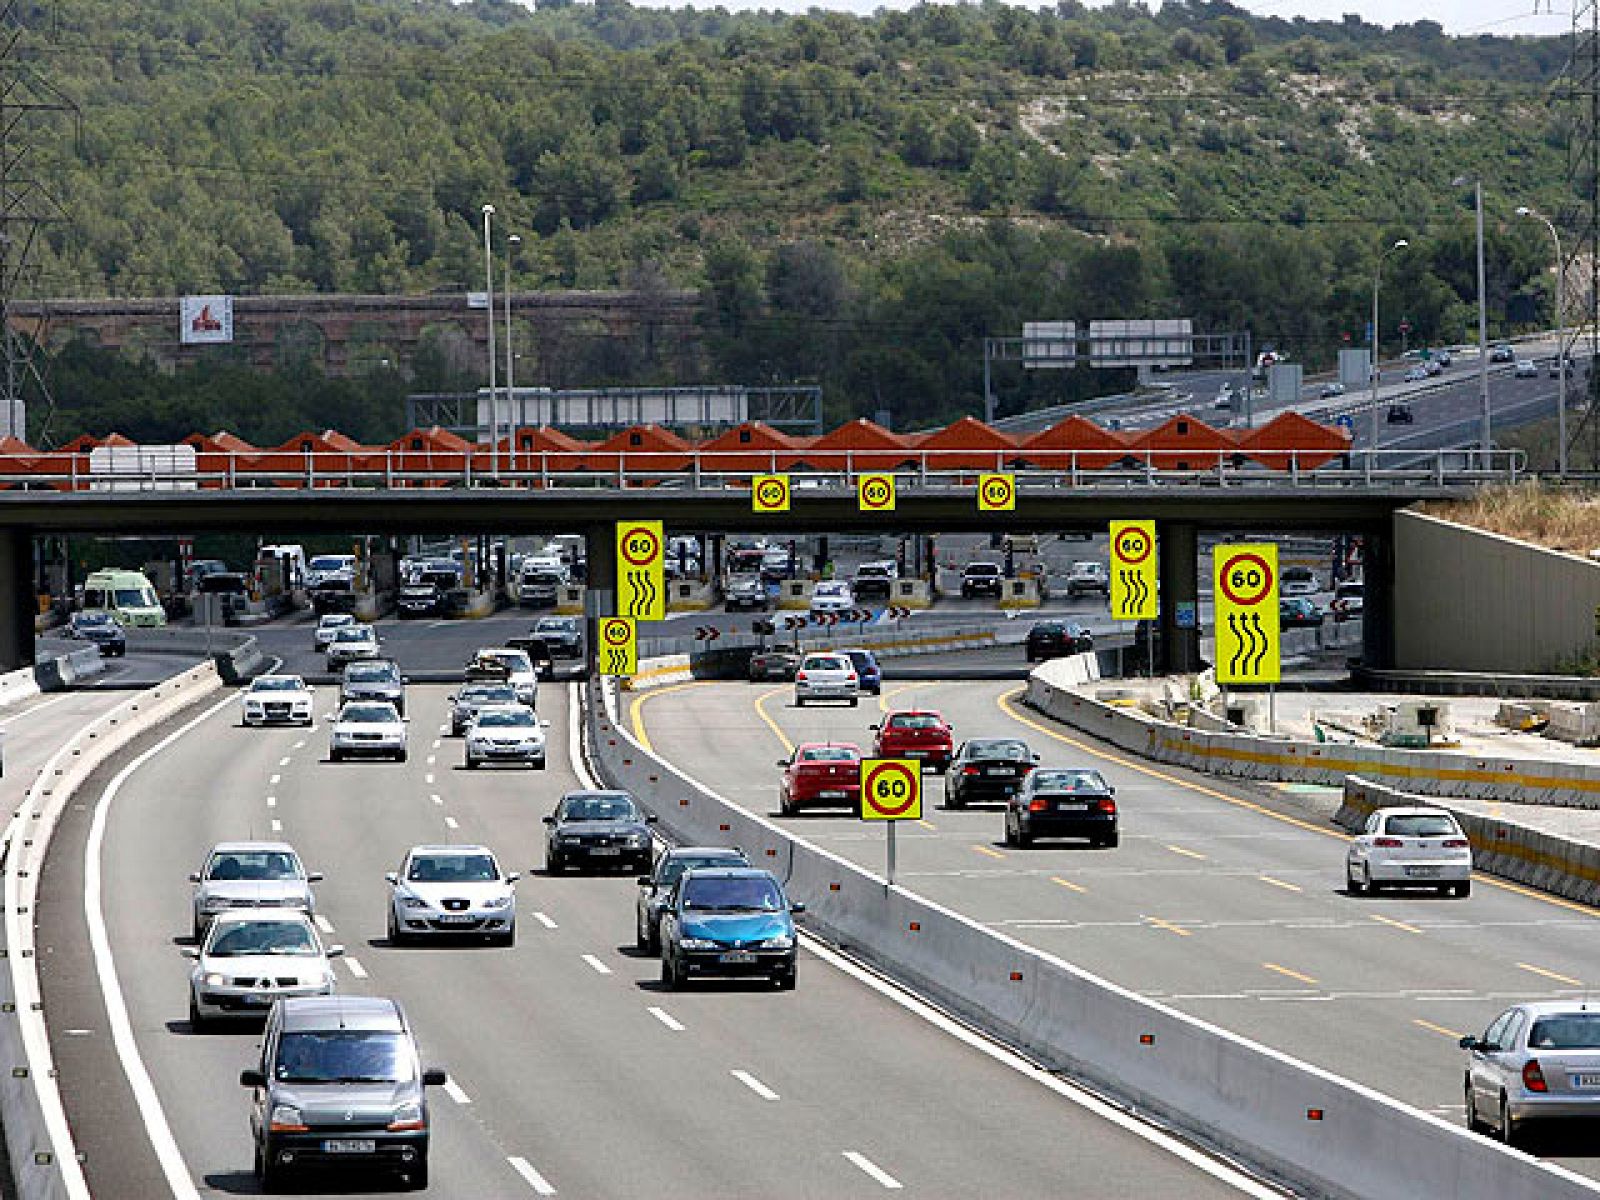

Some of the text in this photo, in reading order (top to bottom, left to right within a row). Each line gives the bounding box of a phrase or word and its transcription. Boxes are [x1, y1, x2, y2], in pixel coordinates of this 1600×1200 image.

[867, 486, 886, 499] 60
[989, 486, 1006, 499] 60
[629, 539, 651, 554] 60
[1121, 539, 1144, 553] 60
[1231, 569, 1261, 589] 60
[876, 779, 906, 799] 60
